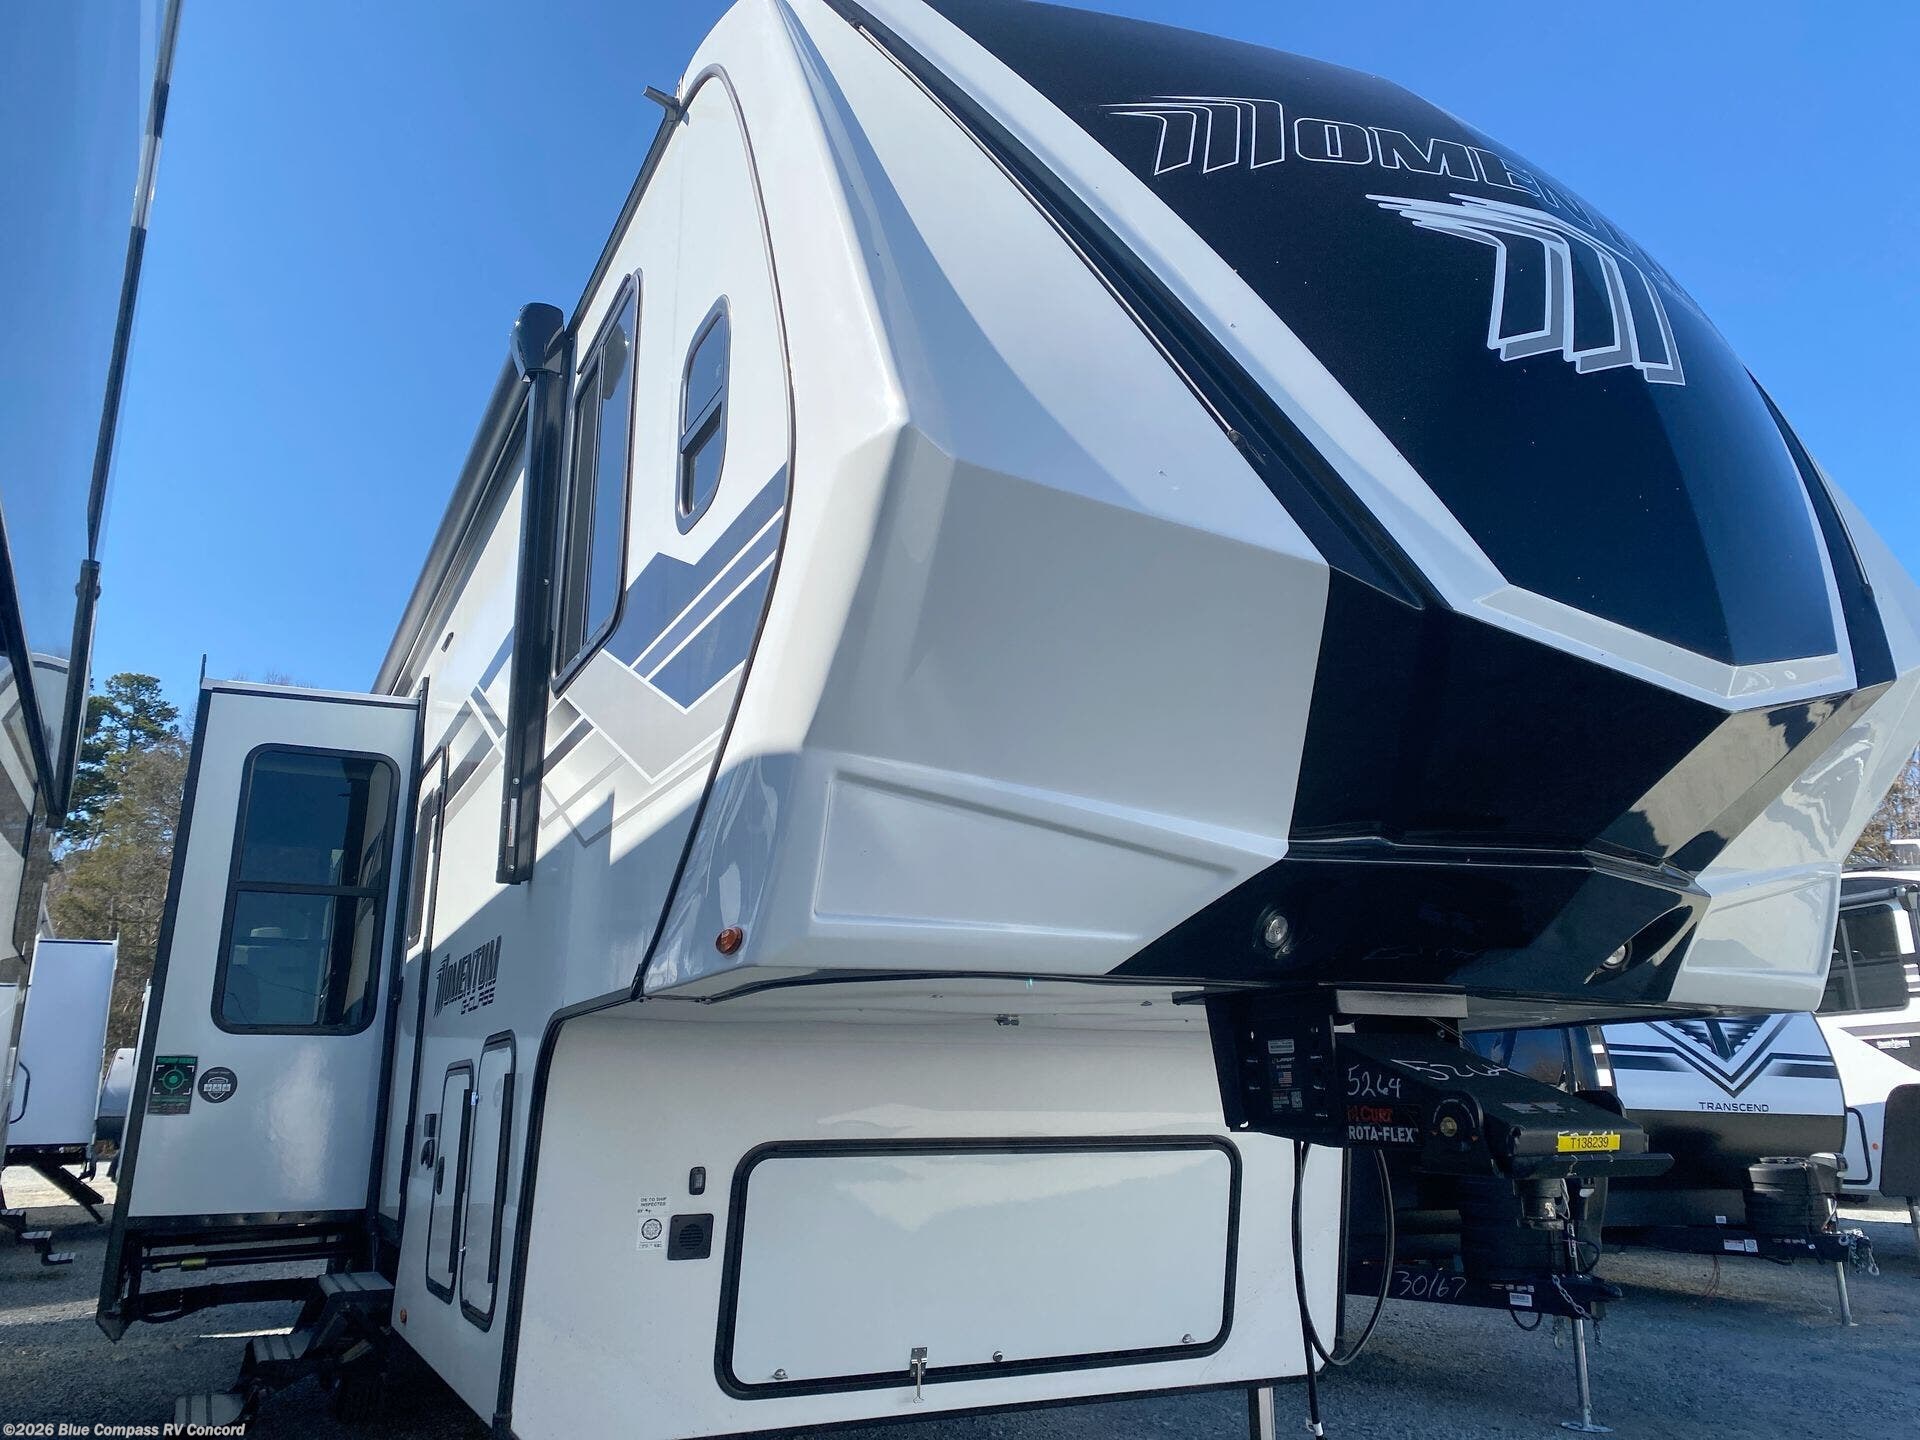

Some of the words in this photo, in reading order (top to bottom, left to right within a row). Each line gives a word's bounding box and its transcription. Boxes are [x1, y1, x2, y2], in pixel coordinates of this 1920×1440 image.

[1347, 1064, 1401, 1098] 5264
[1698, 1101, 1769, 1112] TRANSCEND
[1570, 1137, 1610, 1149] T138239
